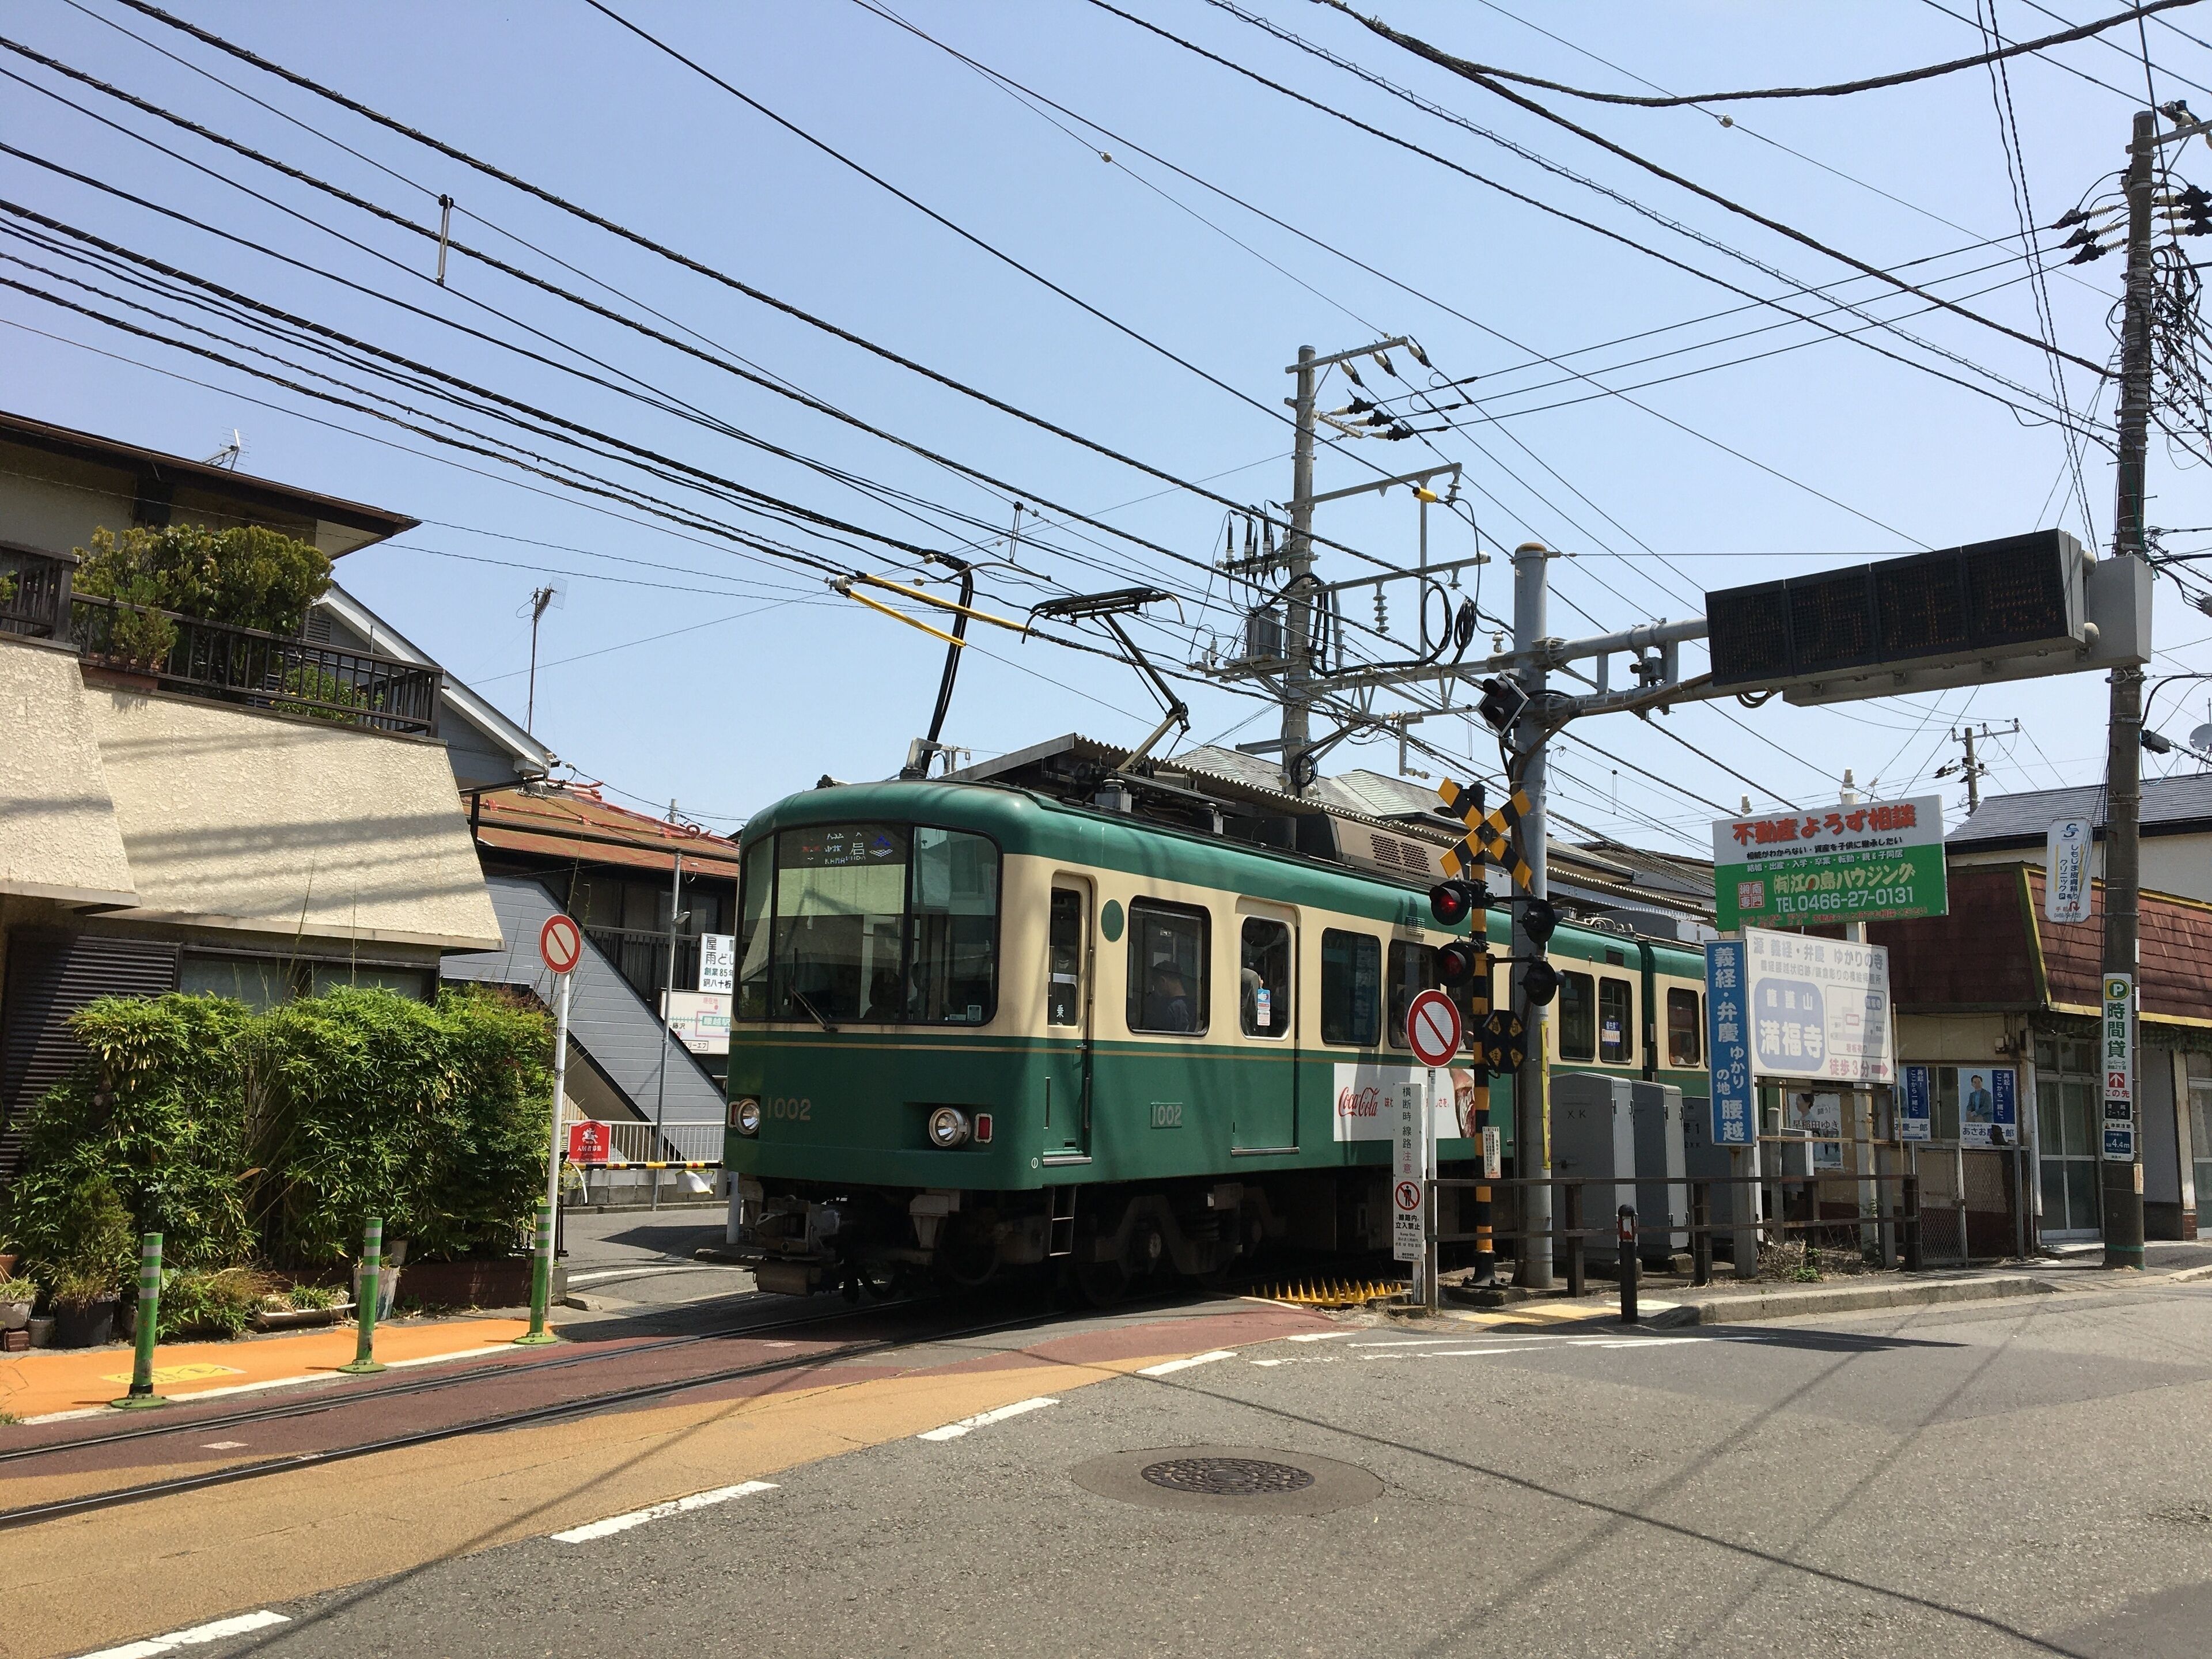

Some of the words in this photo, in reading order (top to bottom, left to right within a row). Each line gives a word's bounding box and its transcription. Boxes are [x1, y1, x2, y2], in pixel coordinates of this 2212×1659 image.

[1732, 804, 1916, 846] 不動産よろず相談
[2059, 859, 2068, 892] クリニック
[1776, 897, 1796, 913] TEL
[1798, 887, 1913, 911] 0466-27-0131
[1834, 948, 1883, 971] ゆかりの寺
[1714, 947, 1739, 1043] 義経・弁慶
[1760, 1020, 1823, 1058] 満福寺
[2107, 1002, 2126, 1059] 時間貸
[1730, 1046, 1745, 1089] ゆかり
[1717, 1069, 1730, 1095] の地
[2105, 1089, 2130, 1098] この先
[767, 1097, 811, 1120] 1002
[1338, 1086, 1380, 1117] Coca-Cola
[1153, 1105, 1181, 1125] 1002
[1722, 1100, 1745, 1142] 腰越
[1793, 1120, 1839, 1130] 早稲田ゆき
[2112, 1138, 2130, 1149] 4.4m
[1395, 1222, 1421, 1230] 立入禁止
[1398, 1214, 1418, 1222] 線路内
